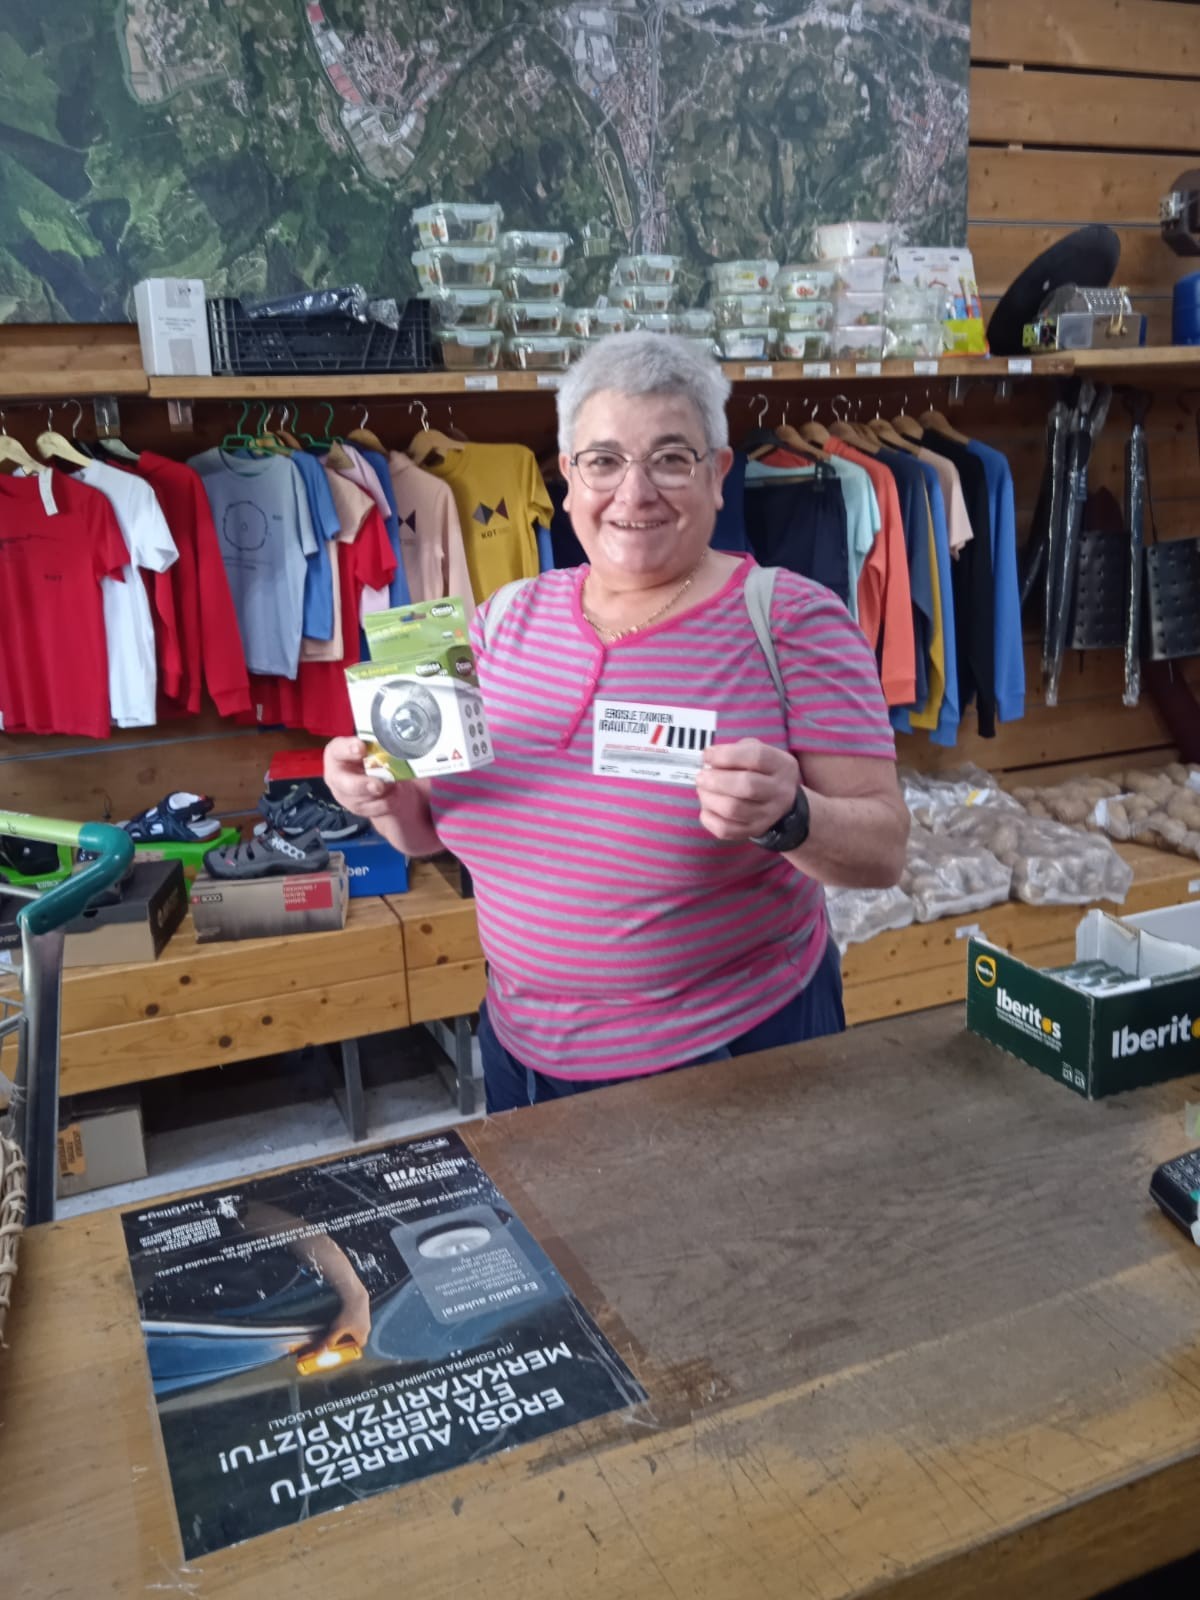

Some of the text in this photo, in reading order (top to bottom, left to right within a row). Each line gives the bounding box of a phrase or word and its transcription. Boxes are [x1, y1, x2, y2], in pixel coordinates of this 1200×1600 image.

[996, 986, 1062, 1040] Iberitos
[396, 1367, 445, 1388] ILUMINA
[446, 1351, 495, 1372] COMPRA
[219, 1343, 571, 1472] MERKATARITZA PIZTU!
[314, 1389, 378, 1415] COMERCIO
[379, 1383, 395, 1394] EL
[306, 1382, 516, 1465] ETA HERRIKO
[271, 1388, 564, 1503] EROSI, AURREZTU
